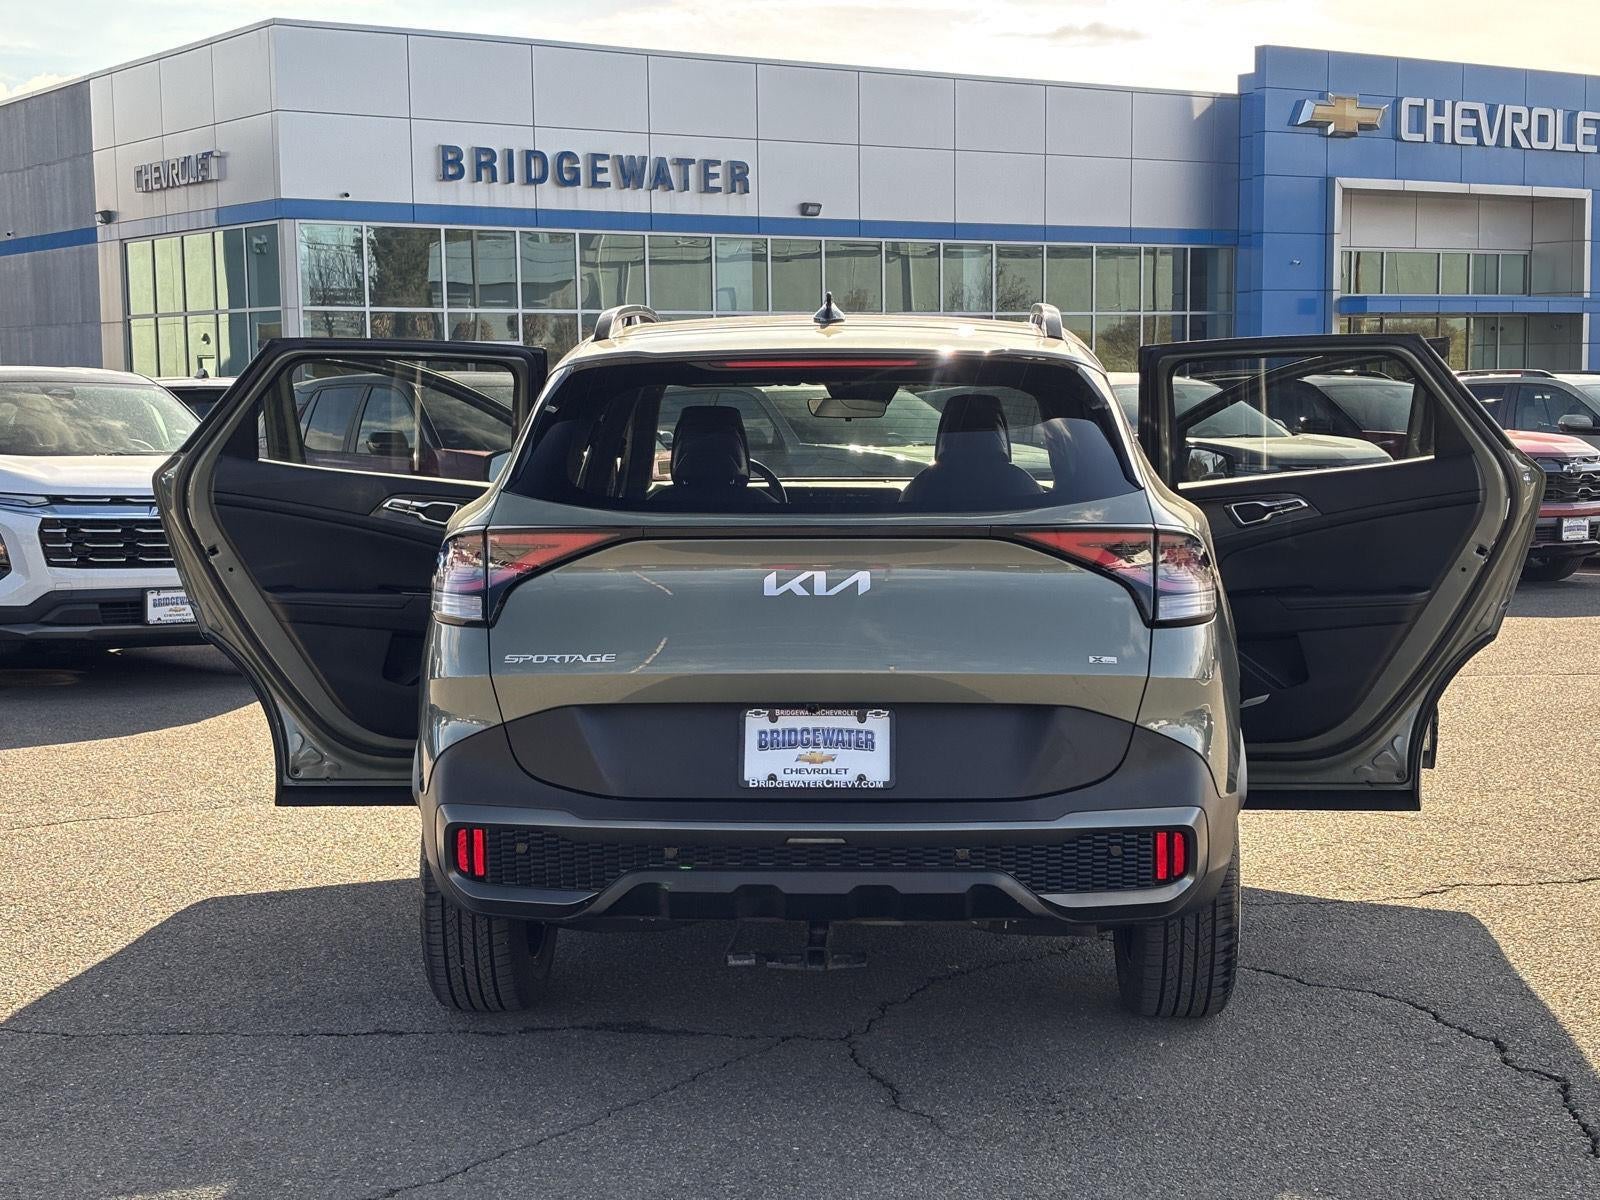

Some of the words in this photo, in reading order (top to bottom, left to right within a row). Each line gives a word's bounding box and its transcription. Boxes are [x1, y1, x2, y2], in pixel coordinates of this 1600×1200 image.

[1401, 96, 1600, 153] CHEVROLE
[134, 150, 221, 193] CHEVROLET
[437, 144, 751, 194] BRIDGEWATER
[763, 570, 871, 596] KIA
[504, 653, 617, 664] SPORTAGE
[757, 727, 875, 751] BRIDGEWATER
[783, 767, 849, 775] CHEVROLET
